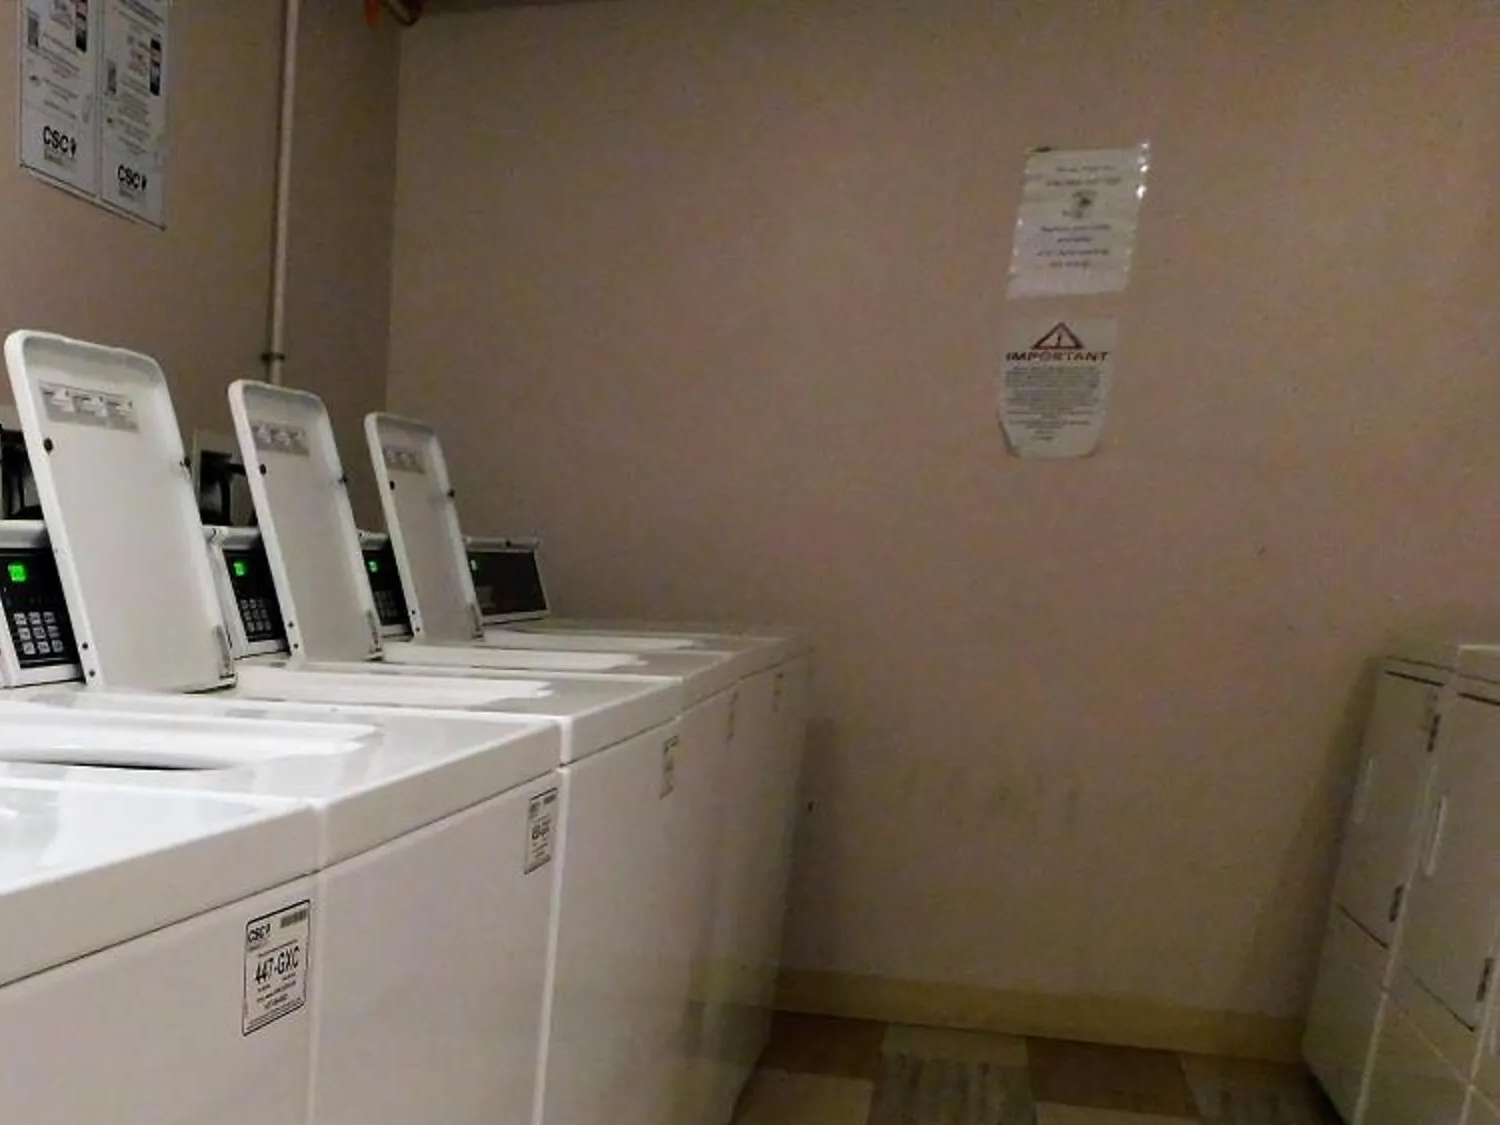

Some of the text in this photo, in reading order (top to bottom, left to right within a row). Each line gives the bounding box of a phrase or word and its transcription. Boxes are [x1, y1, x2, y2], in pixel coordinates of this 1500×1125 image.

[42, 125, 69, 153] CSC
[117, 164, 142, 189] CSC
[1005, 351, 1108, 361] IMPORTANT
